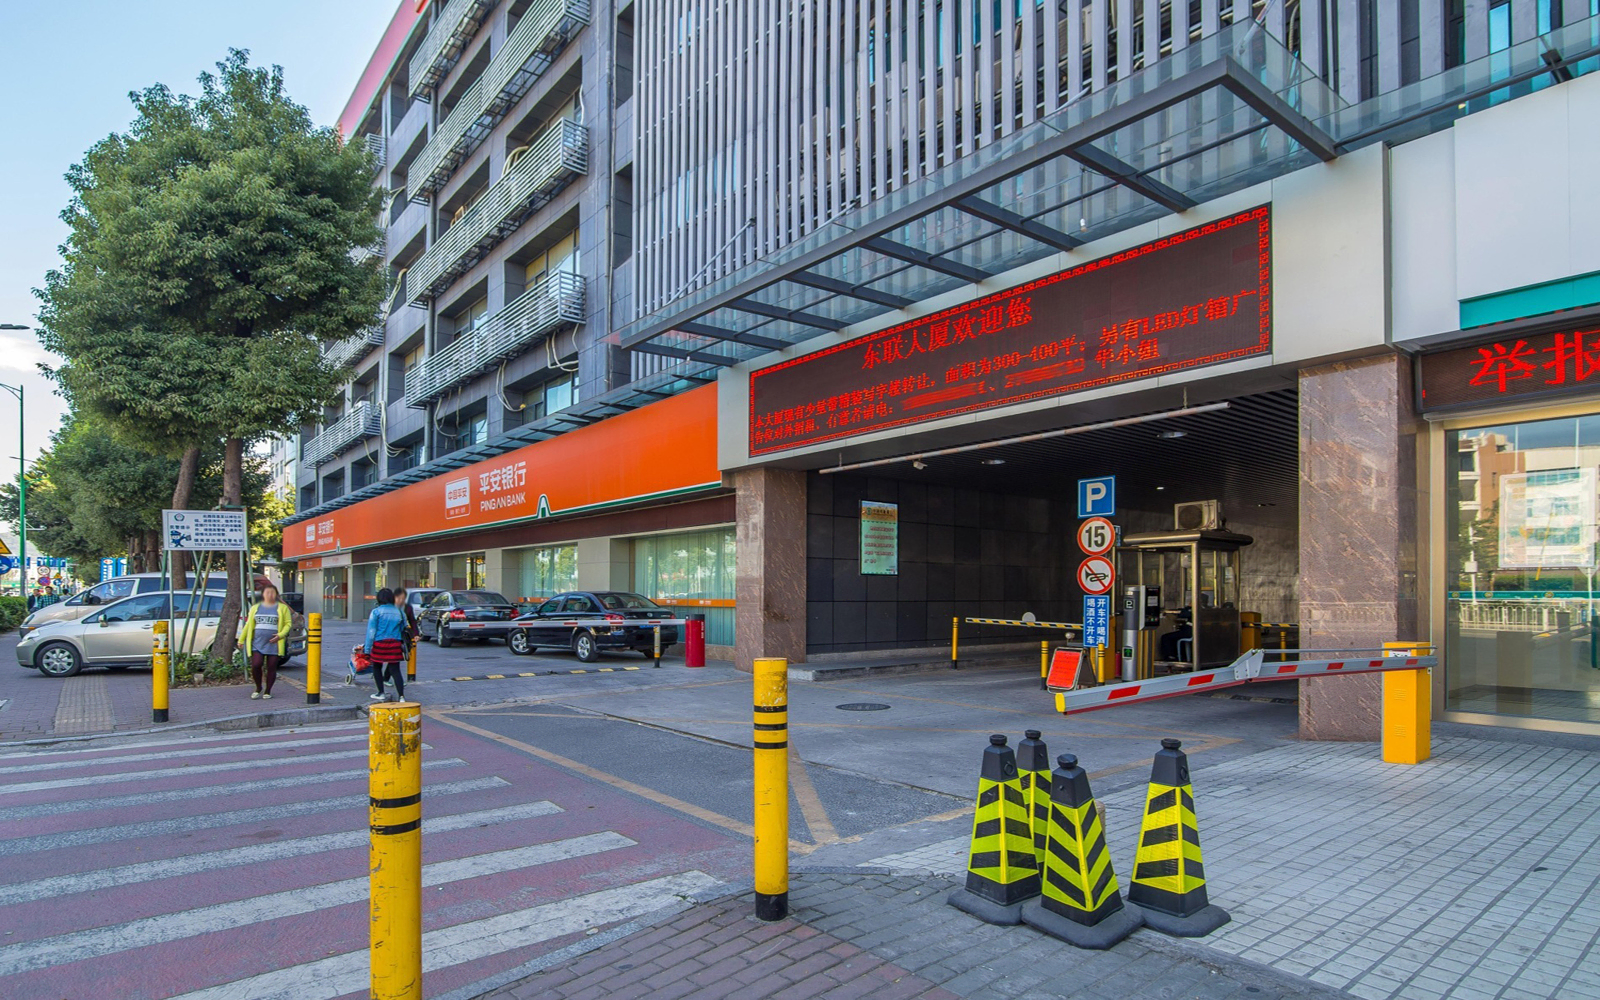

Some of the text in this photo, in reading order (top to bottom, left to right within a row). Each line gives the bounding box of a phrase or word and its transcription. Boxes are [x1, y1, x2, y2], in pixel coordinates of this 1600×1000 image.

[861, 297, 1033, 369] 东联大厦欢迎您
[447, 487, 468, 501] 中国平安
[479, 461, 527, 495] 平安银行
[1086, 482, 1107, 512] P
[1085, 526, 1106, 548] 15
[1086, 598, 1096, 645] 喝酒不开车
[1097, 598, 1107, 644] 开车不喝酒
